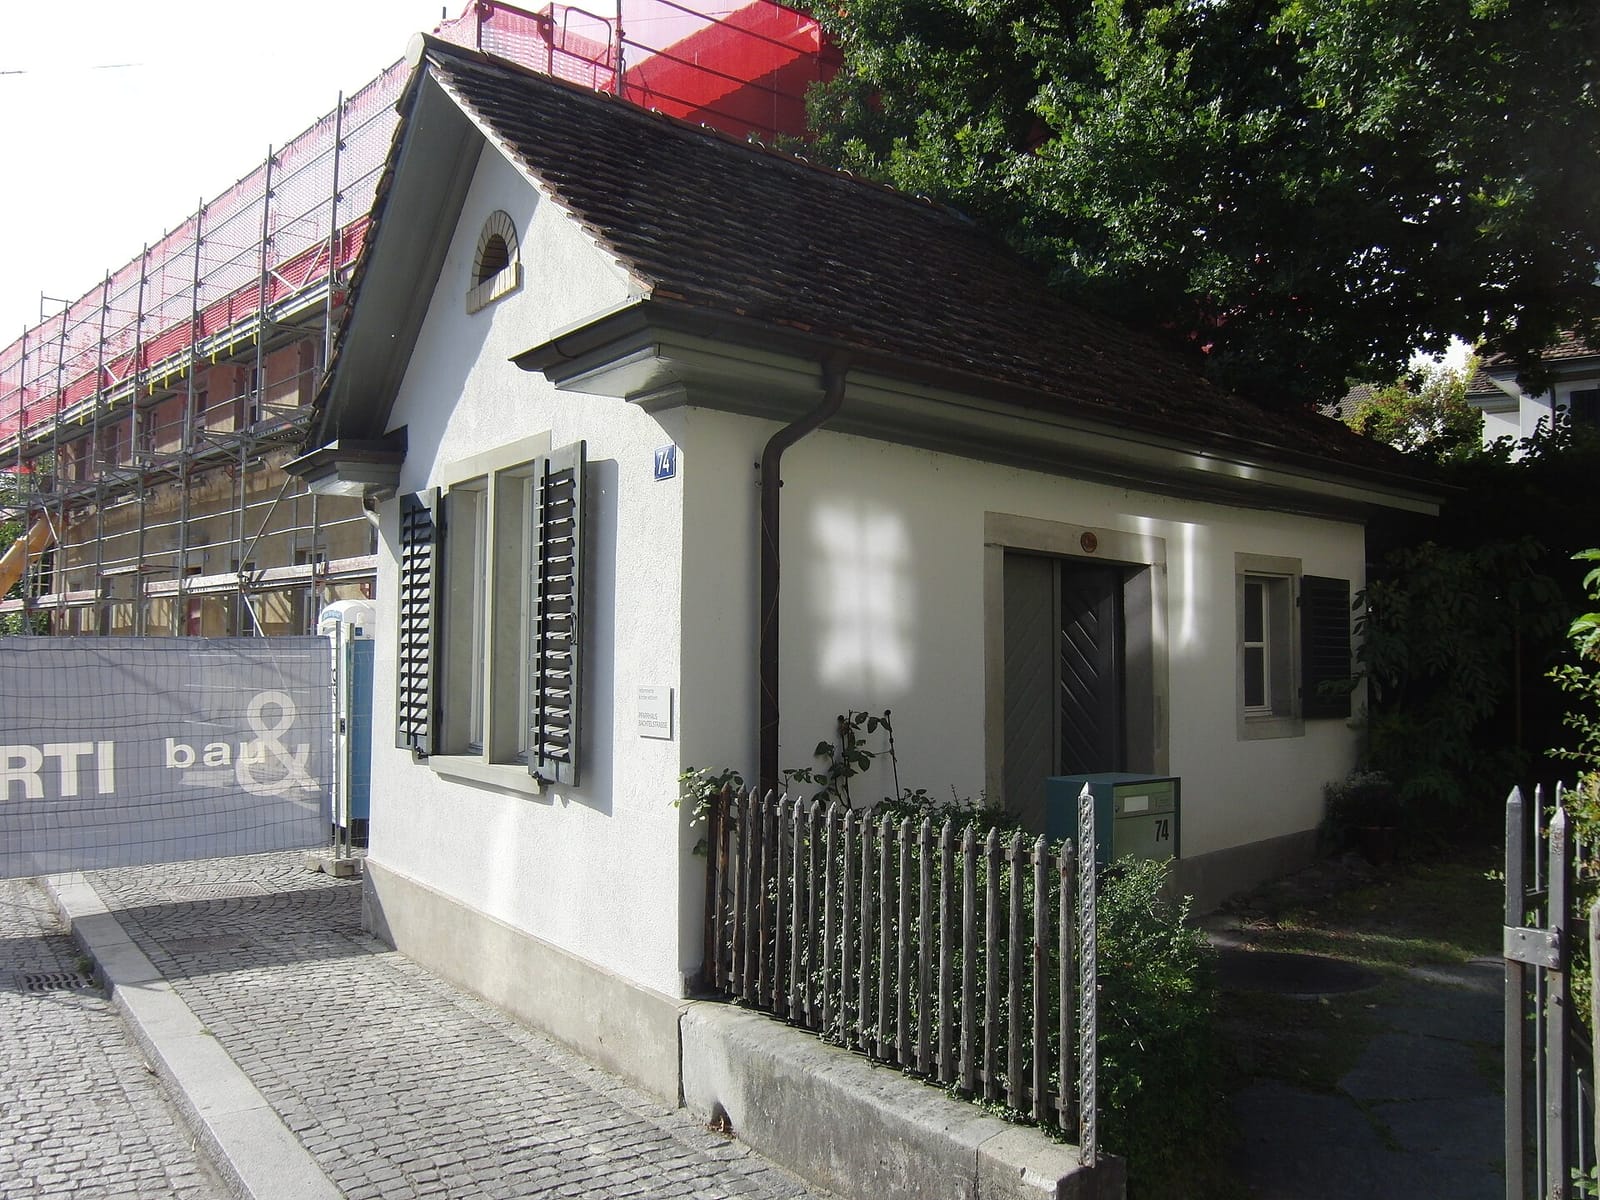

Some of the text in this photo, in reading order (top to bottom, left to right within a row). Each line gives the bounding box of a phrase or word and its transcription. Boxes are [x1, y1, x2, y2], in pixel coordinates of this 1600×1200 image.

[658, 449, 670, 475] 74
[0, 738, 265, 801] RTI bau
[1155, 819, 1169, 842] 74
